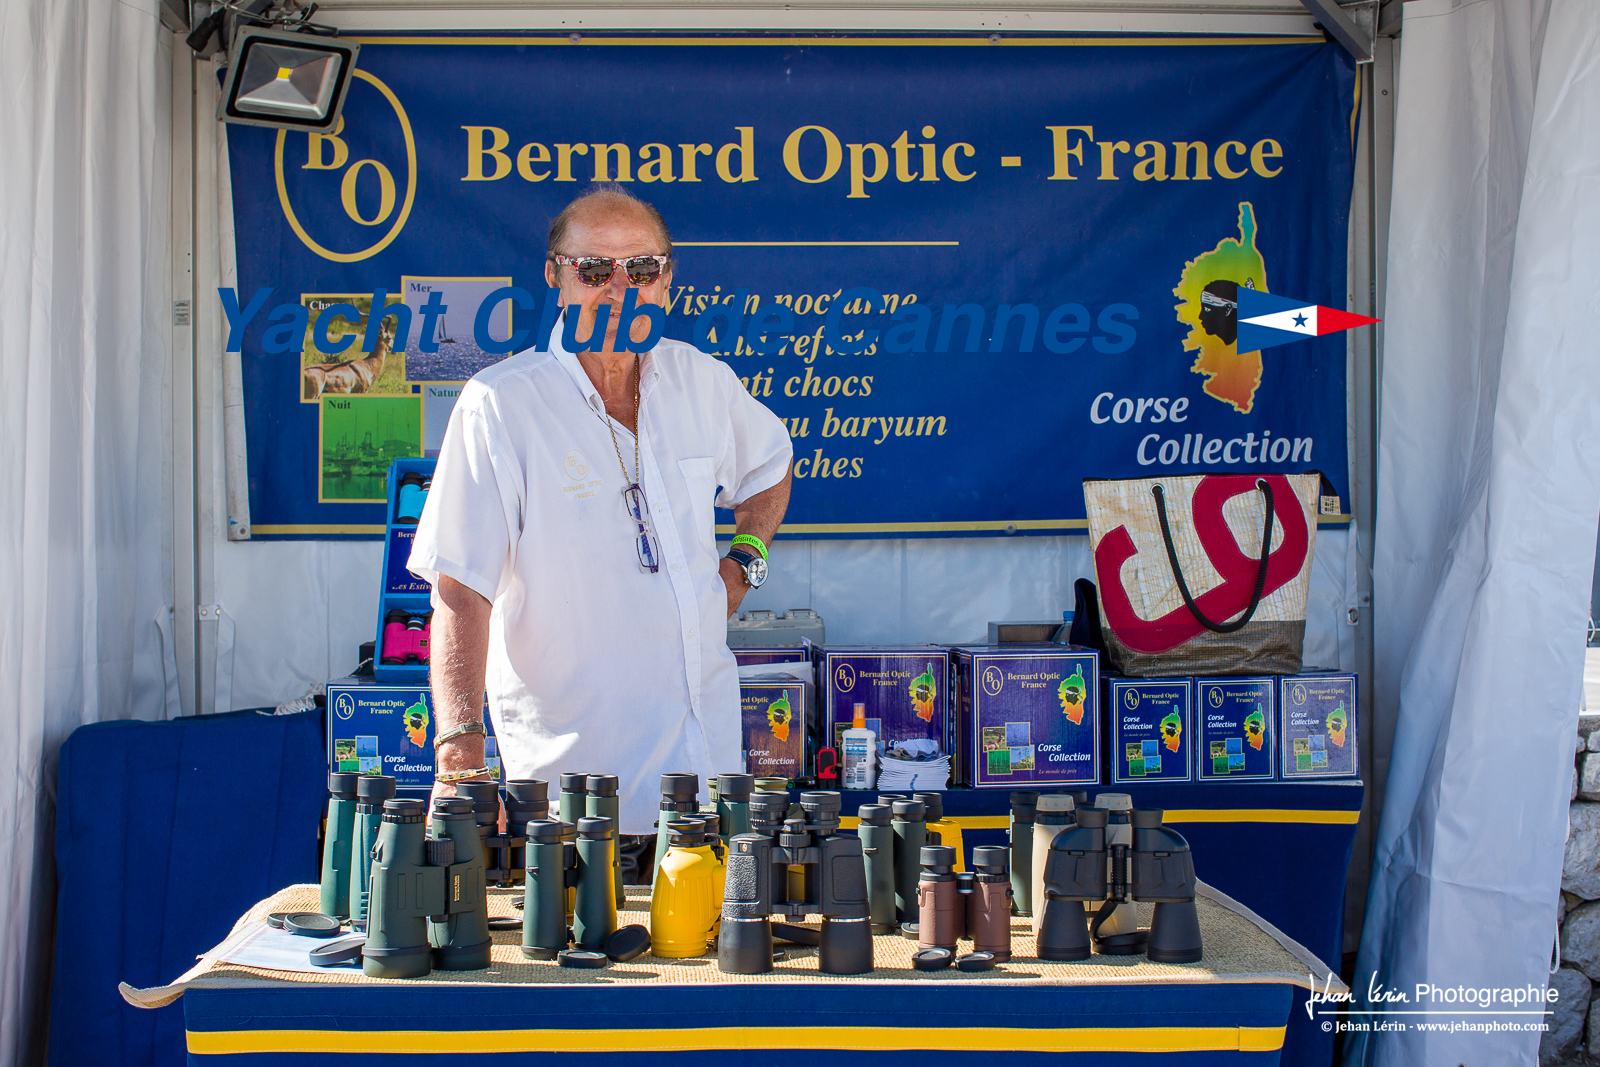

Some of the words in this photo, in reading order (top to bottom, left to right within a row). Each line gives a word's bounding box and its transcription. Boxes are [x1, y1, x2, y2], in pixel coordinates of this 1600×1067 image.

[461, 125, 759, 184] Bernard
[783, 125, 977, 198] Optic
[1001, 156, 1021, 167] -
[1045, 125, 1284, 182] France
[410, 282, 432, 293] Mer
[784, 366, 874, 397] chocs
[328, 399, 352, 410] Nuit
[1090, 391, 1189, 424] Corse
[821, 407, 947, 445] baryum
[1137, 430, 1313, 465] Collection
[793, 448, 864, 478] ches
[859, 670, 889, 678] Bernard
[891, 670, 912, 679] Optic
[1007, 672, 1038, 680] Bernard
[1040, 672, 1061, 681] Optic
[1021, 681, 1047, 689] France
[1249, 690, 1263, 698] Optic
[387, 700, 406, 708] Optic
[751, 696, 770, 704] Optic
[1291, 718, 1320, 726] Collection
[1037, 743, 1062, 752] Corse
[749, 748, 770, 757] Corse
[1048, 752, 1091, 762] Collection
[384, 754, 406, 763] Corse
[758, 757, 796, 765] Collection
[394, 763, 433, 772] Collection
